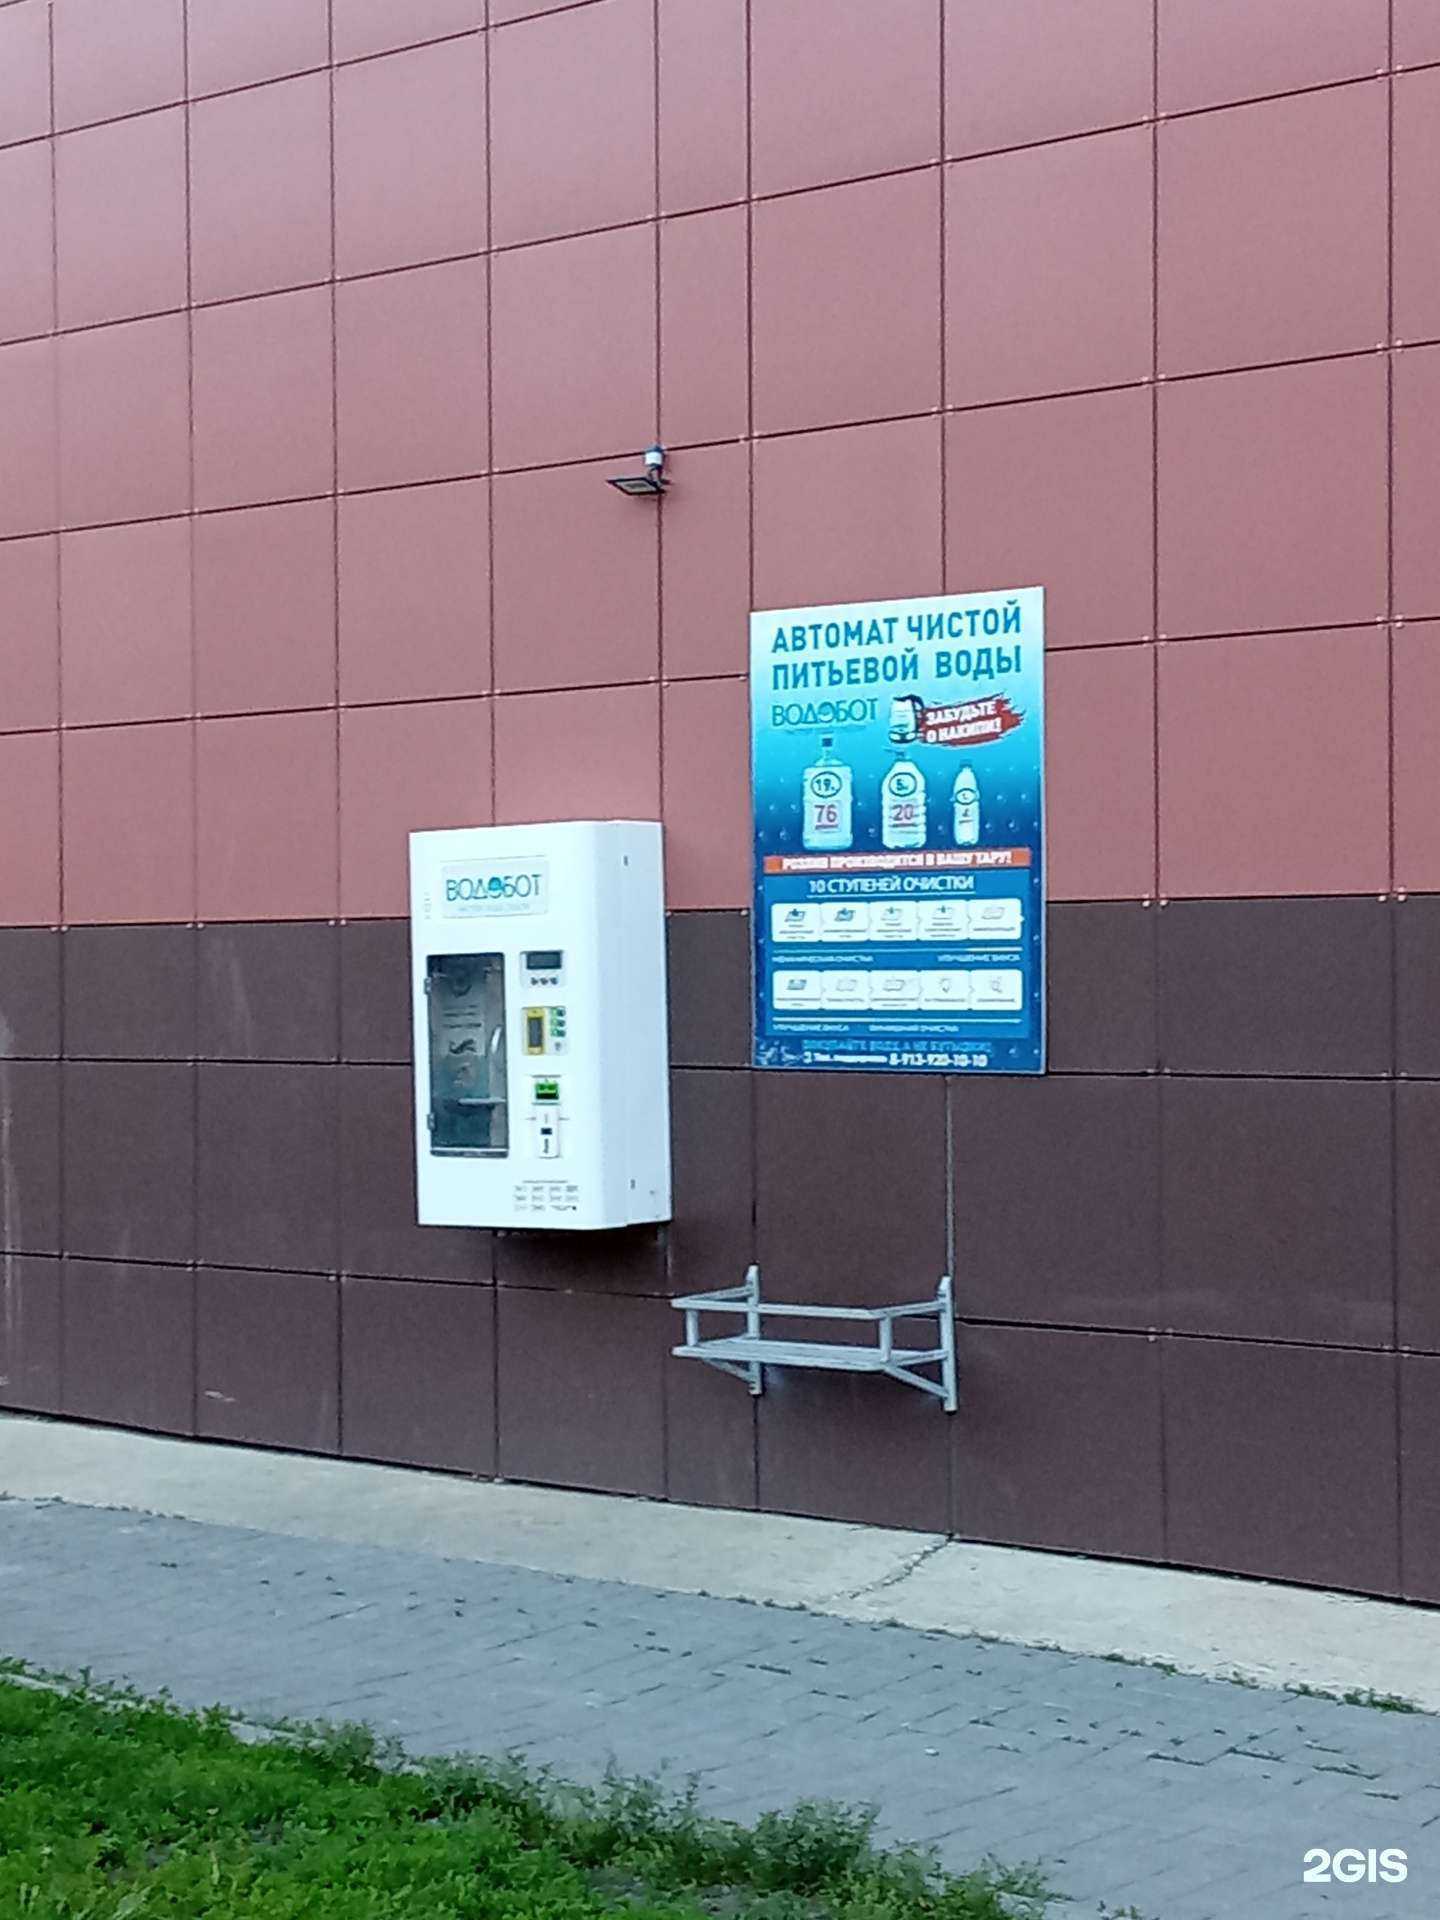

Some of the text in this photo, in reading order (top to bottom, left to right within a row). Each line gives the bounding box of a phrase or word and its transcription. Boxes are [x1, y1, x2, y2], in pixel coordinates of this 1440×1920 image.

[771, 600, 1021, 653] АВТОМАТ ЧИСТОЙ
[772, 645, 1022, 690] ПИТЬЕВОЙ ВОДЫ
[772, 698, 878, 727] ВОДОБОТ
[814, 804, 838, 823] 76
[891, 803, 914, 822] 20
[446, 874, 540, 902] ВОДОБОТ
[828, 875, 901, 894] СТУПЕНЕЙ
[902, 875, 974, 893] ОЧИСТКИ
